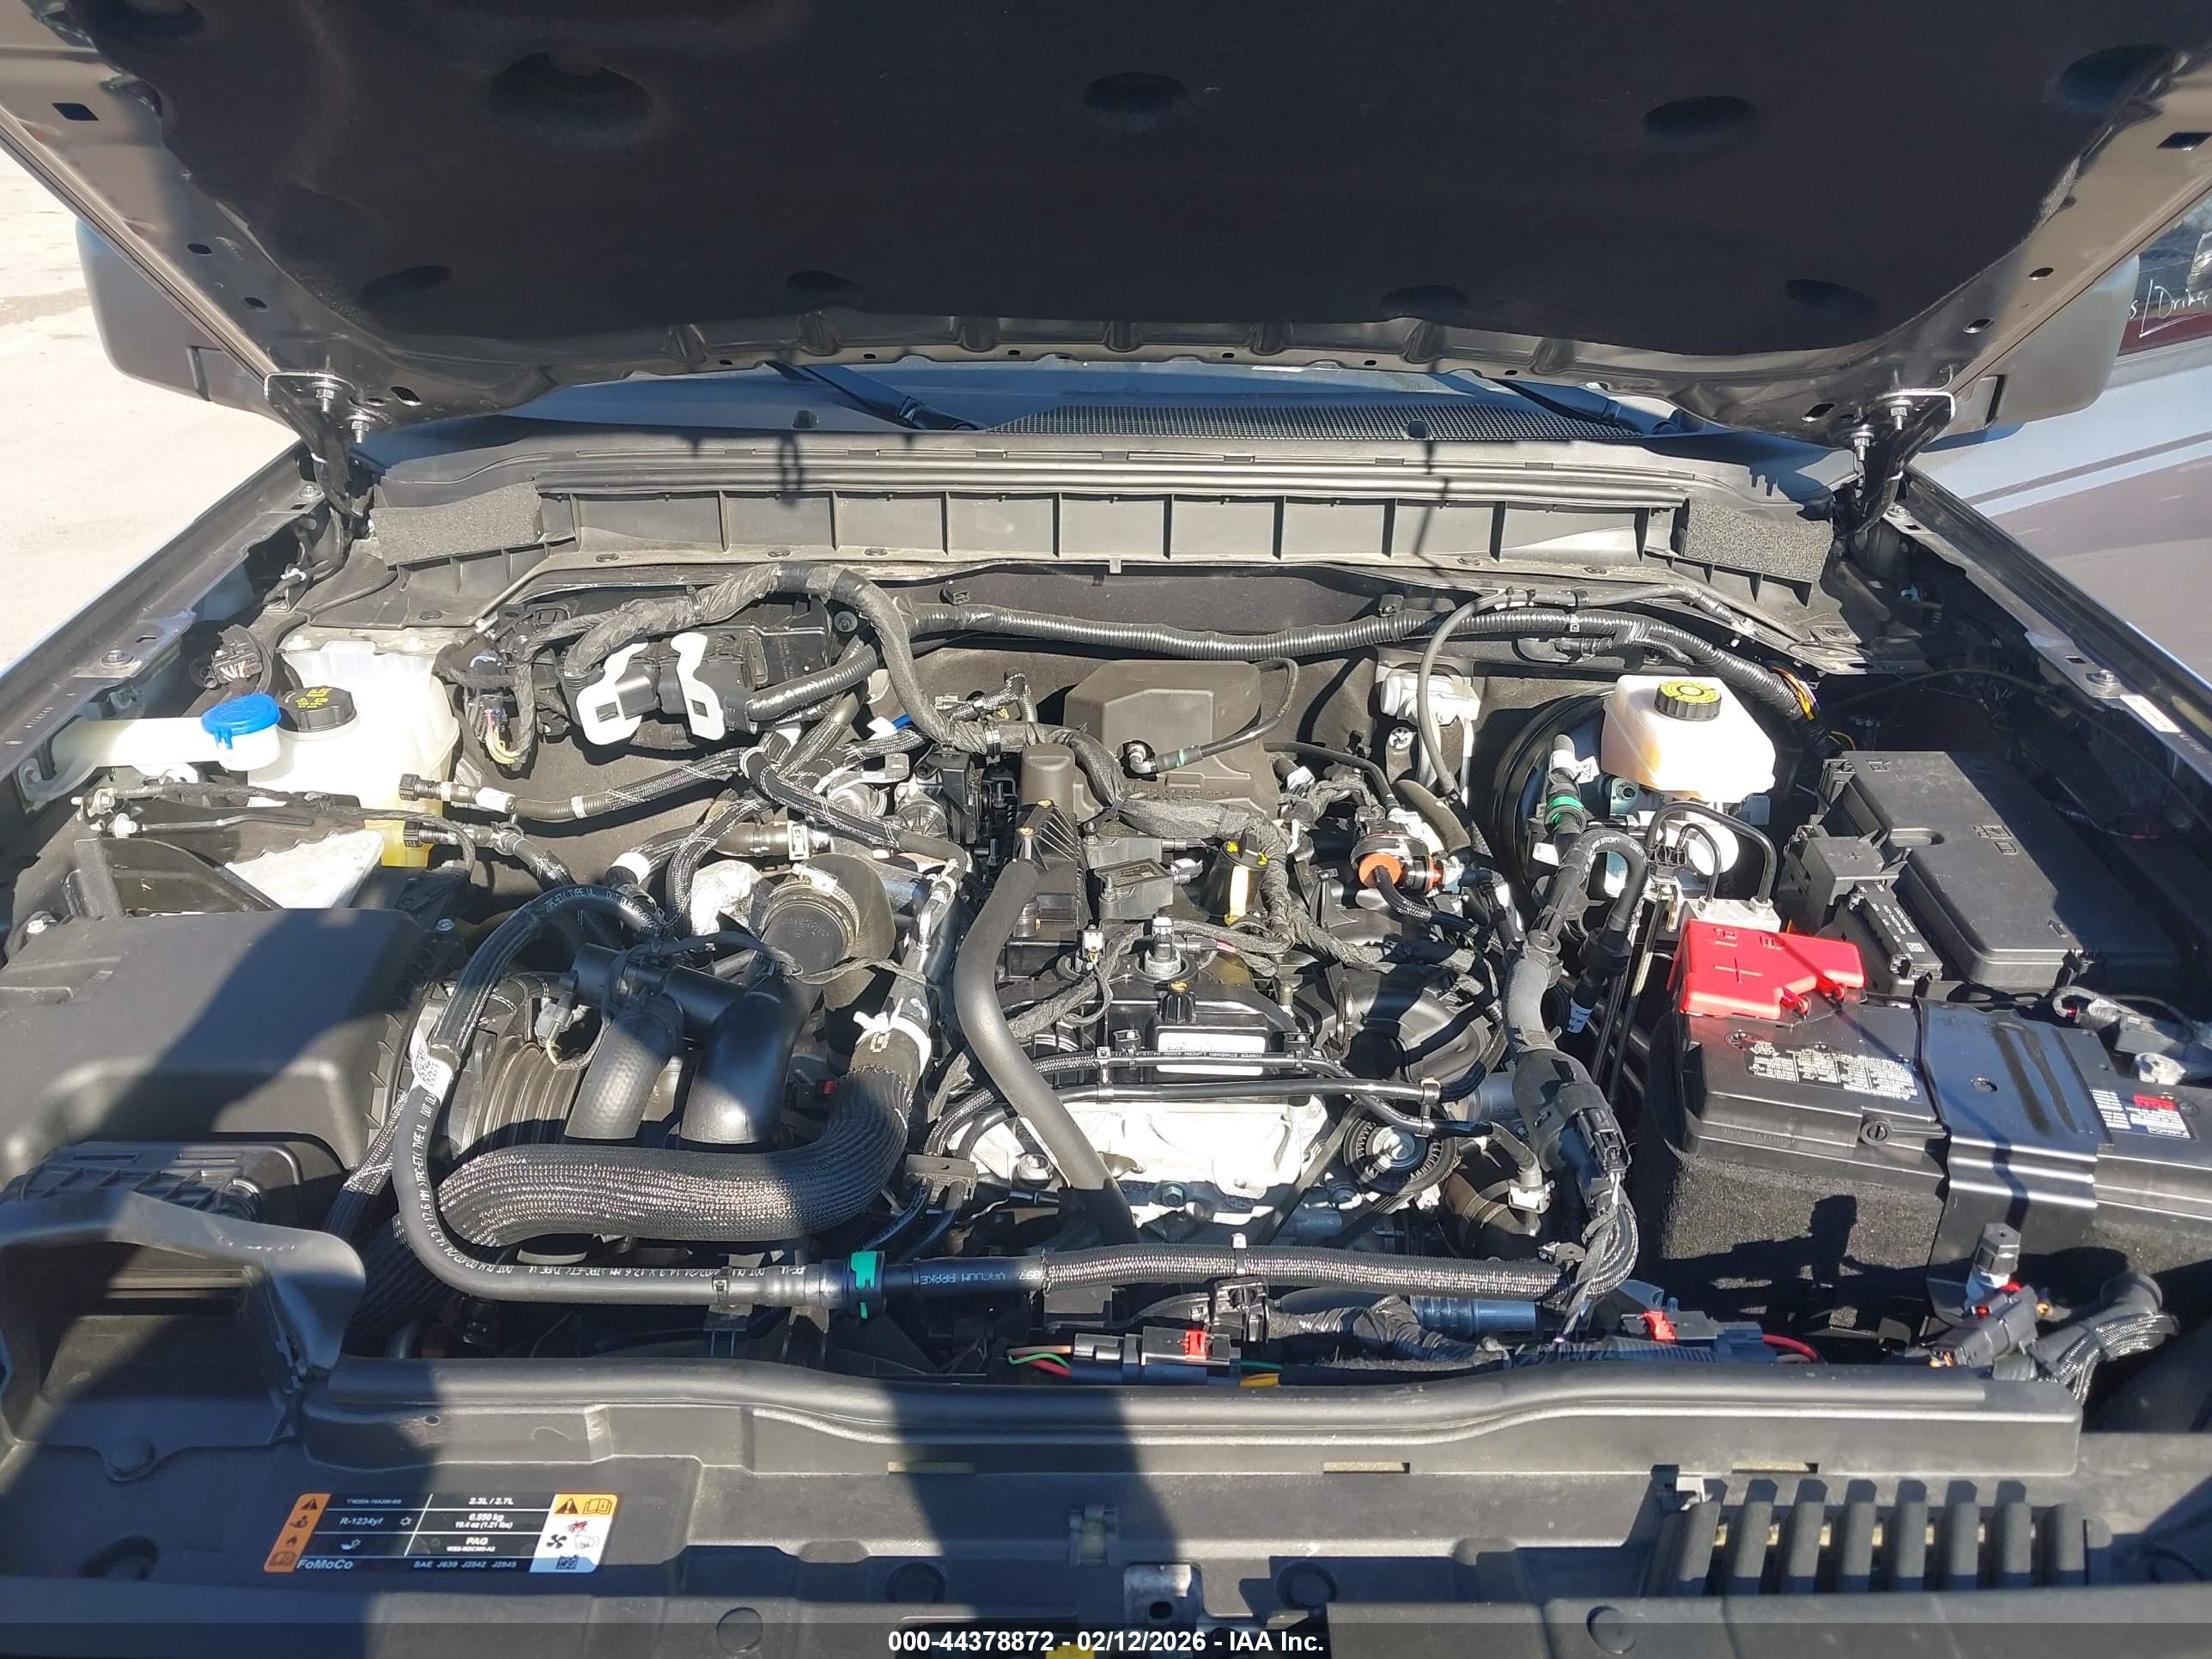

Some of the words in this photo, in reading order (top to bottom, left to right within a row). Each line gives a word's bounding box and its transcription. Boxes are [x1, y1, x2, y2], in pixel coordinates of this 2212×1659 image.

[920, 1273, 957, 1286] BRAKE
[961, 1271, 1006, 1283] VACUUM
[339, 1516, 385, 1527] R-1234yf
[468, 1513, 492, 1522] 0.550
[493, 1513, 505, 1522] kg
[480, 1522, 497, 1530] (1.21
[499, 1522, 514, 1530] lbs)
[465, 1537, 489, 1546] PAG
[295, 1559, 354, 1570] FoMoCo
[413, 1560, 434, 1569] SAE
[436, 1560, 459, 1569] J639
